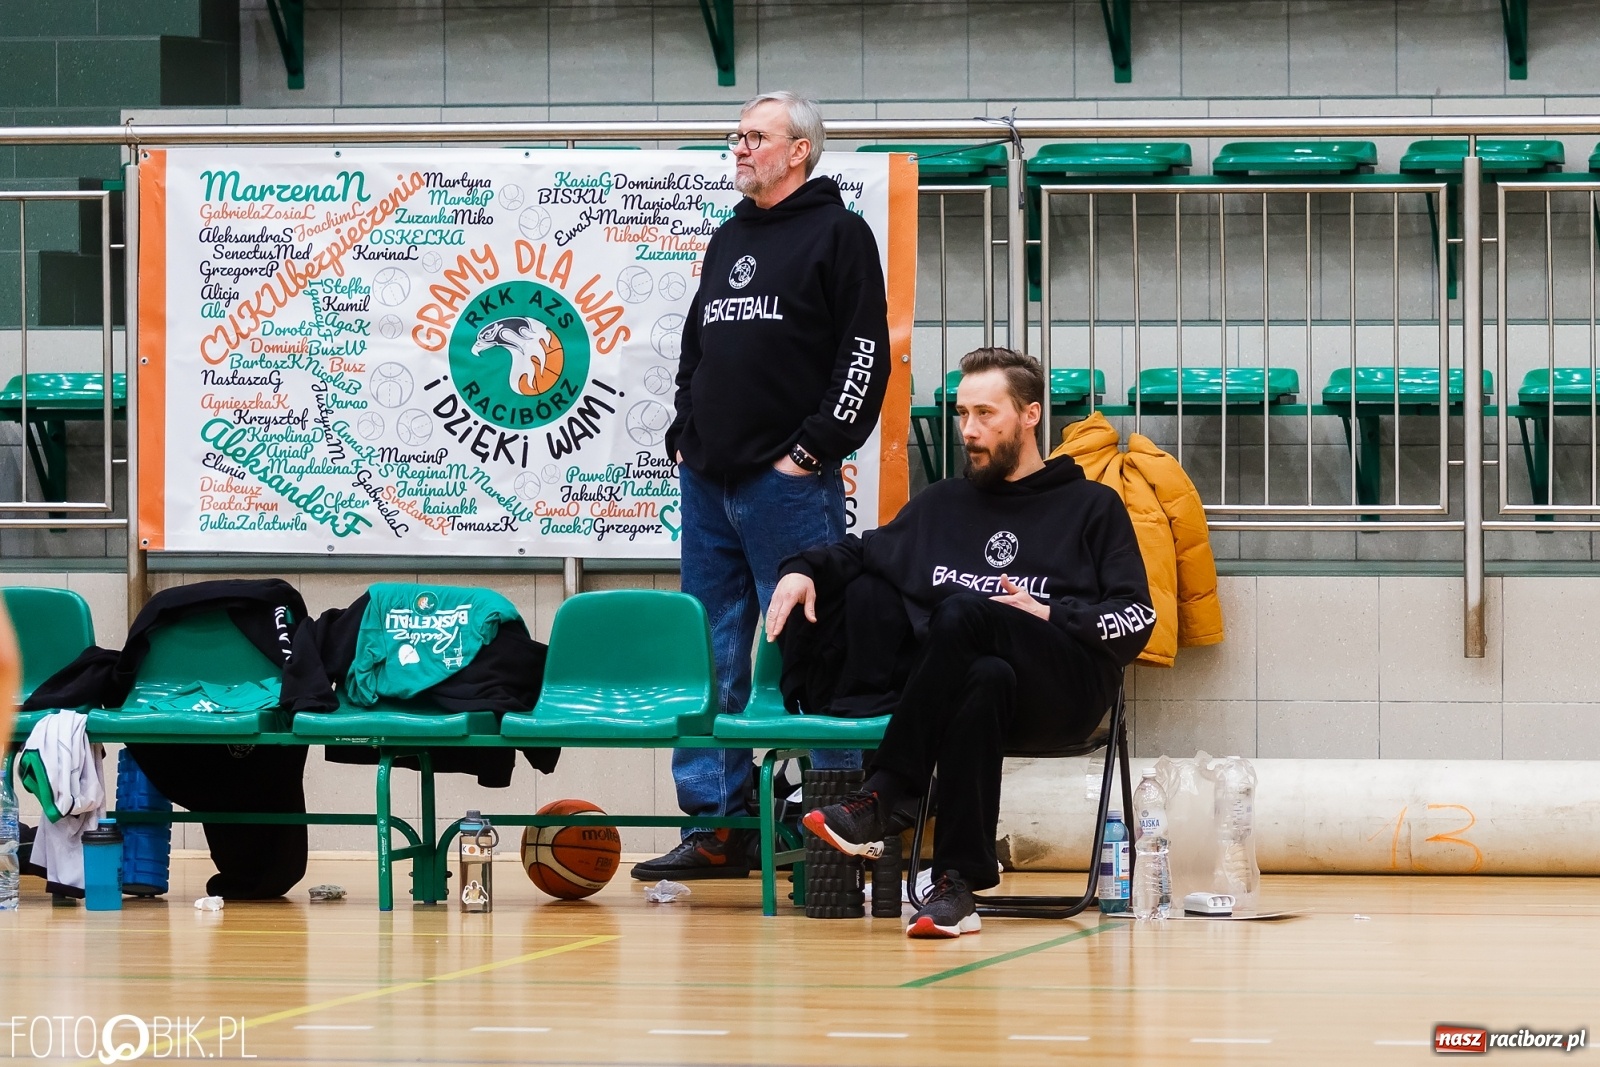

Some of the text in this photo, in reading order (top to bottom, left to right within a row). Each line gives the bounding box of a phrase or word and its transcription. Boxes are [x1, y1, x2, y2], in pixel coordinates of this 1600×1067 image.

[200, 170, 371, 202] MarzenaN
[424, 172, 492, 195] Martyna
[554, 172, 614, 195] KasiaG
[428, 189, 494, 206] MarekP
[538, 188, 606, 204] BISKU
[621, 193, 703, 210] MariolaH
[200, 204, 316, 226] GabrielaZosiaL
[294, 202, 365, 242] JoachimL
[395, 207, 454, 224] Zuzanka
[452, 208, 494, 225] Miko
[598, 208, 669, 226] Maminka
[199, 226, 294, 243] AleksandraS
[554, 206, 600, 247] EwaK
[604, 225, 658, 244] NikolS
[370, 229, 466, 246] OSKELKA
[212, 243, 313, 260] SenectusMed
[352, 244, 419, 260] KarinaL
[636, 244, 697, 260] Zuzanna
[200, 260, 279, 284] GrzegorzP
[200, 283, 240, 308] Alicja
[323, 277, 370, 299] Stefka
[412, 240, 631, 354] GRAMY DLA WAS
[200, 302, 226, 319] Ala
[303, 280, 334, 343] IgnacyF
[322, 295, 370, 312] Kamil
[465, 287, 574, 329] RKK AZS
[261, 320, 312, 336] Dorota
[324, 312, 371, 336] AgaK
[250, 337, 310, 354] Dominik
[308, 340, 367, 356] BuszW
[228, 353, 305, 370] BartoszK
[329, 356, 366, 373] Busz
[201, 370, 284, 393] NastaszaG
[305, 357, 362, 396] NicolaB
[833, 336, 876, 424] PREZES
[200, 392, 290, 416] AgnieszkaK
[326, 392, 368, 410] Varao
[462, 378, 579, 426] RACIBÓRZ
[232, 408, 308, 432] Krzysztof
[312, 380, 346, 465] JustynaM
[246, 426, 324, 444] KarolinaD
[266, 442, 314, 460] AniaP
[378, 447, 448, 465] MarcinP
[202, 452, 246, 480] Elunia
[268, 457, 366, 482] MagdalenaF
[397, 464, 470, 486] ReginaM
[200, 476, 262, 496] Diabeusz
[201, 418, 372, 538] AleksanderF
[396, 480, 467, 497] JaninaW
[470, 466, 534, 523] MarekW
[560, 484, 622, 502] JakubK
[200, 496, 278, 512] BeataFran
[352, 469, 409, 538] GabrielaL
[423, 497, 478, 515] kaisakk
[534, 501, 580, 517] EwaO
[590, 501, 658, 518] CelinaM
[447, 516, 518, 532] TomaszK
[540, 516, 594, 536] JacekJ
[592, 517, 662, 542] Grzegorz
